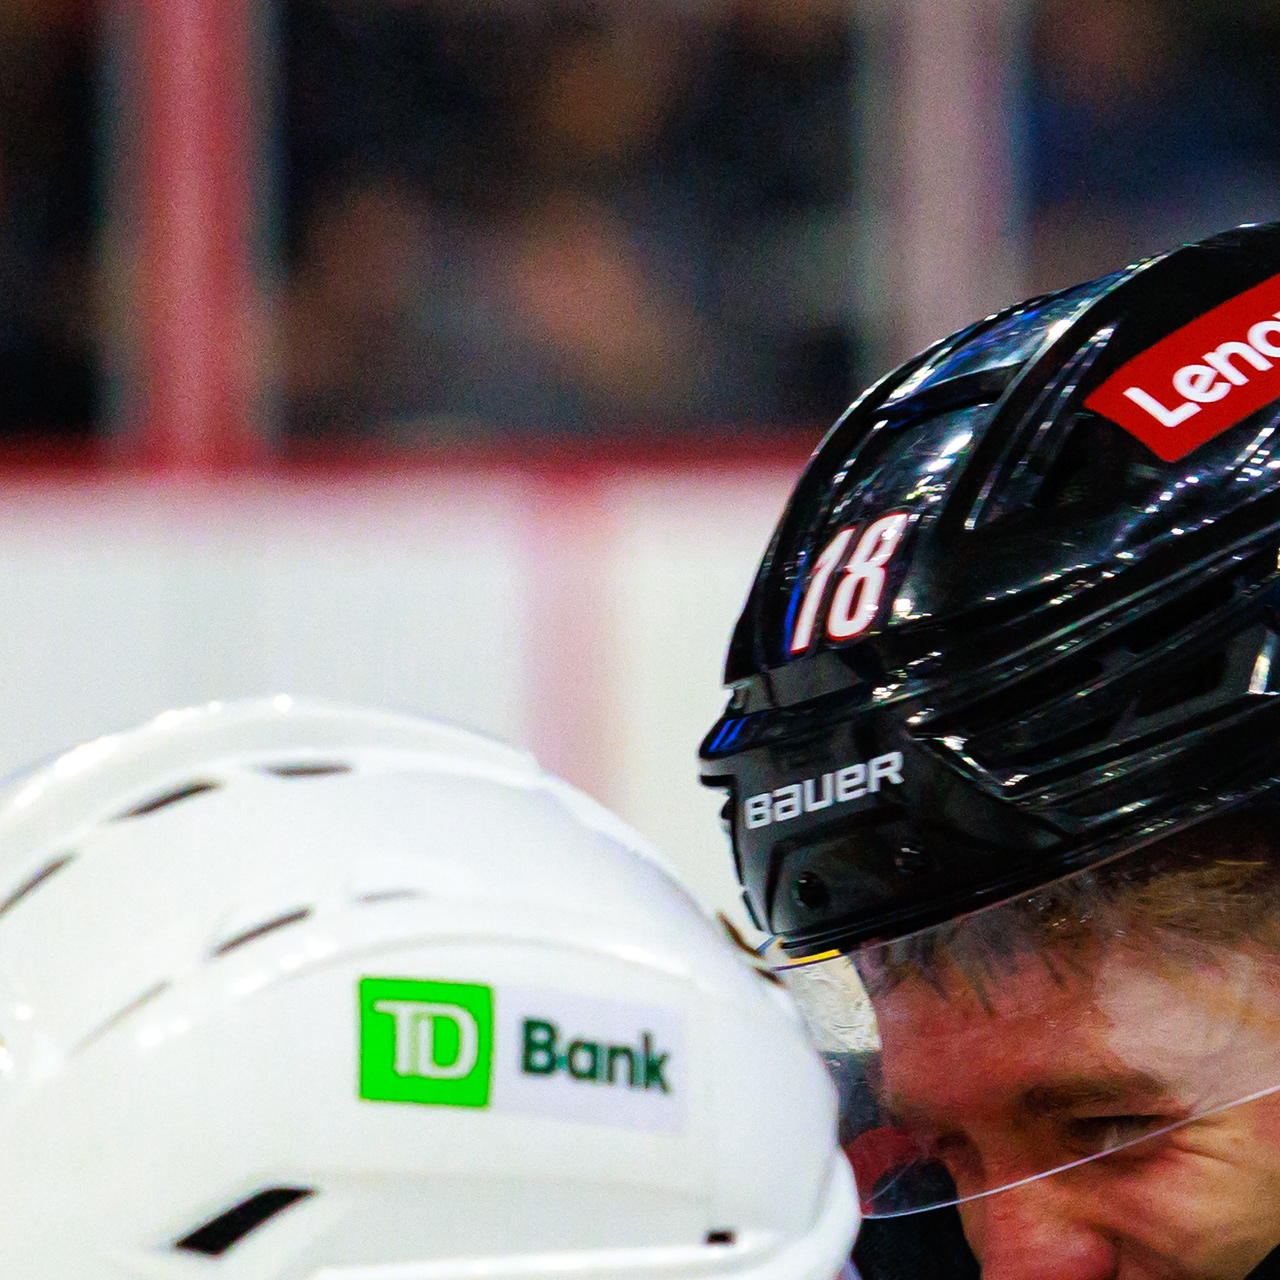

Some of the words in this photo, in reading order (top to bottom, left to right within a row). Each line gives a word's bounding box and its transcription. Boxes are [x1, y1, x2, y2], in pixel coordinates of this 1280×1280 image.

[791, 512, 909, 653] 18
[744, 751, 905, 830] BAUER
[374, 1000, 477, 1079] TD
[521, 1015, 670, 1094] Bank
